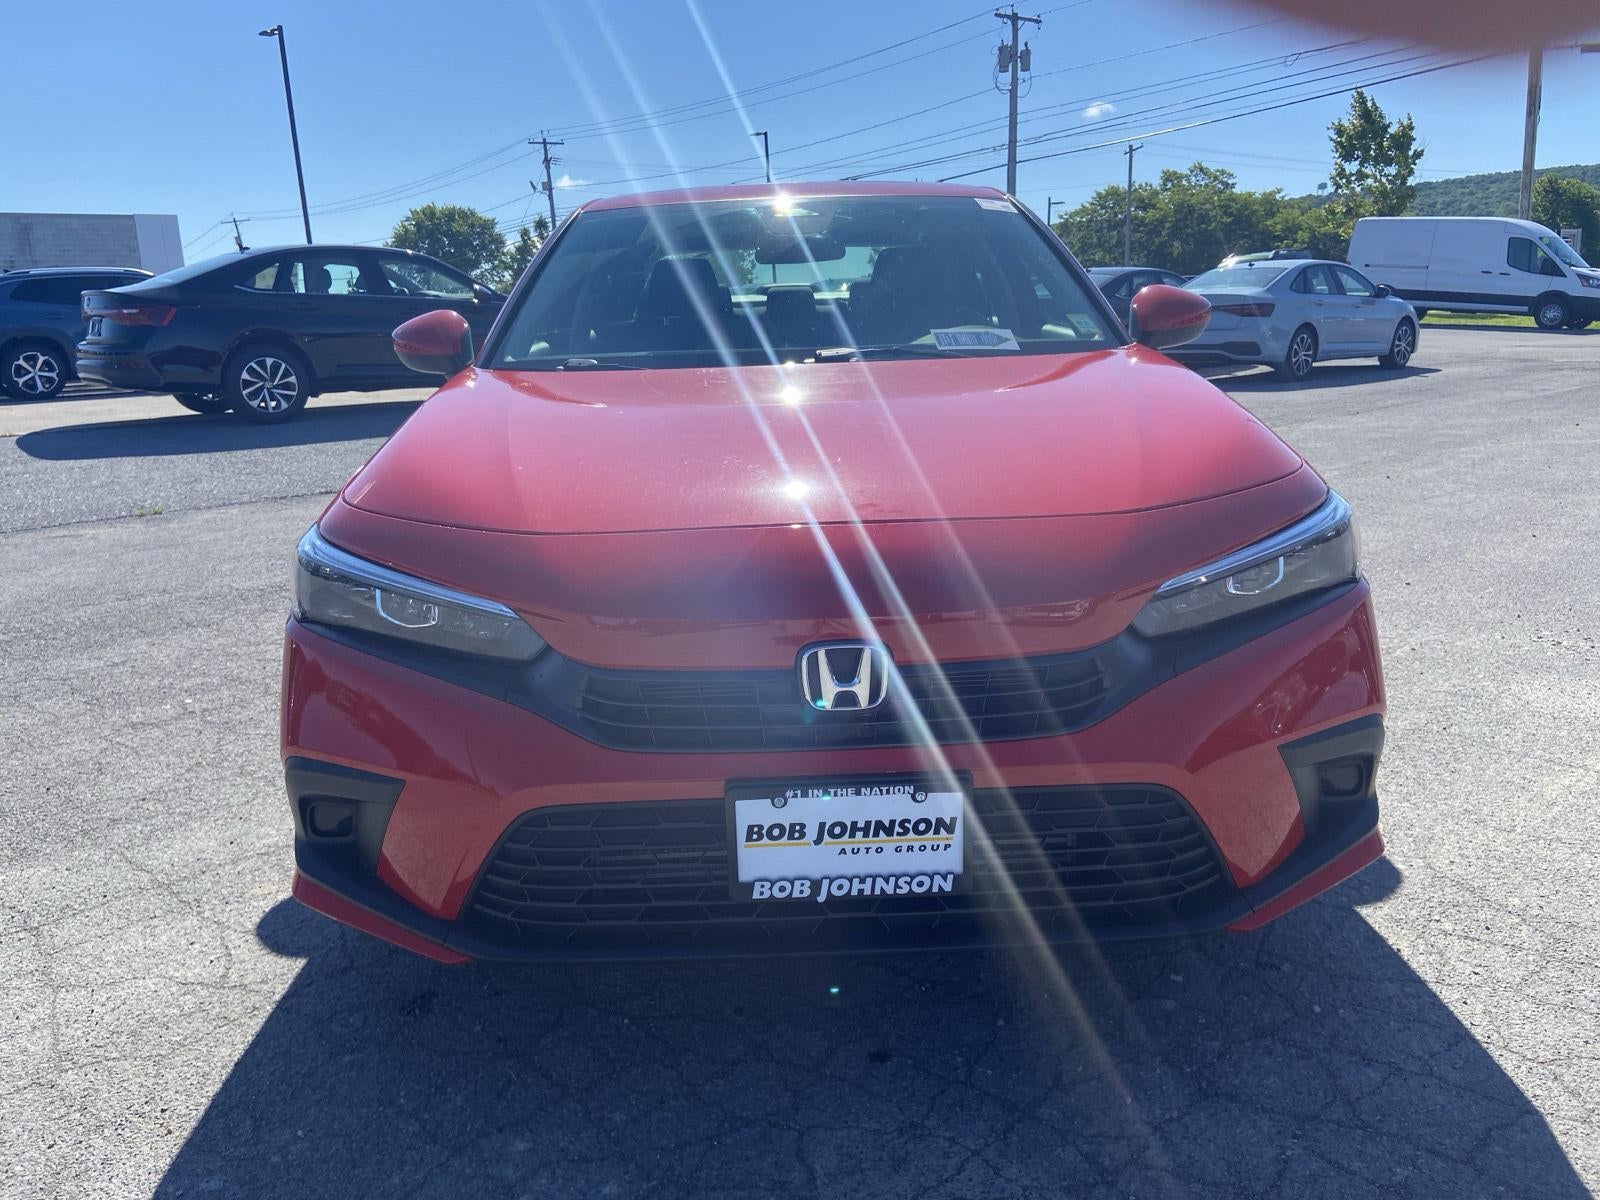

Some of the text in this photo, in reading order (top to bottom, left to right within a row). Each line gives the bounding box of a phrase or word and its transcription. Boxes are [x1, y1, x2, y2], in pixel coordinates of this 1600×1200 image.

[785, 785, 914, 798] #1 IN THE NATION
[745, 817, 957, 845] BOB JOHNSON
[838, 843, 951, 855] AUTO GROUP
[752, 874, 953, 902] BOB JOHNSON
